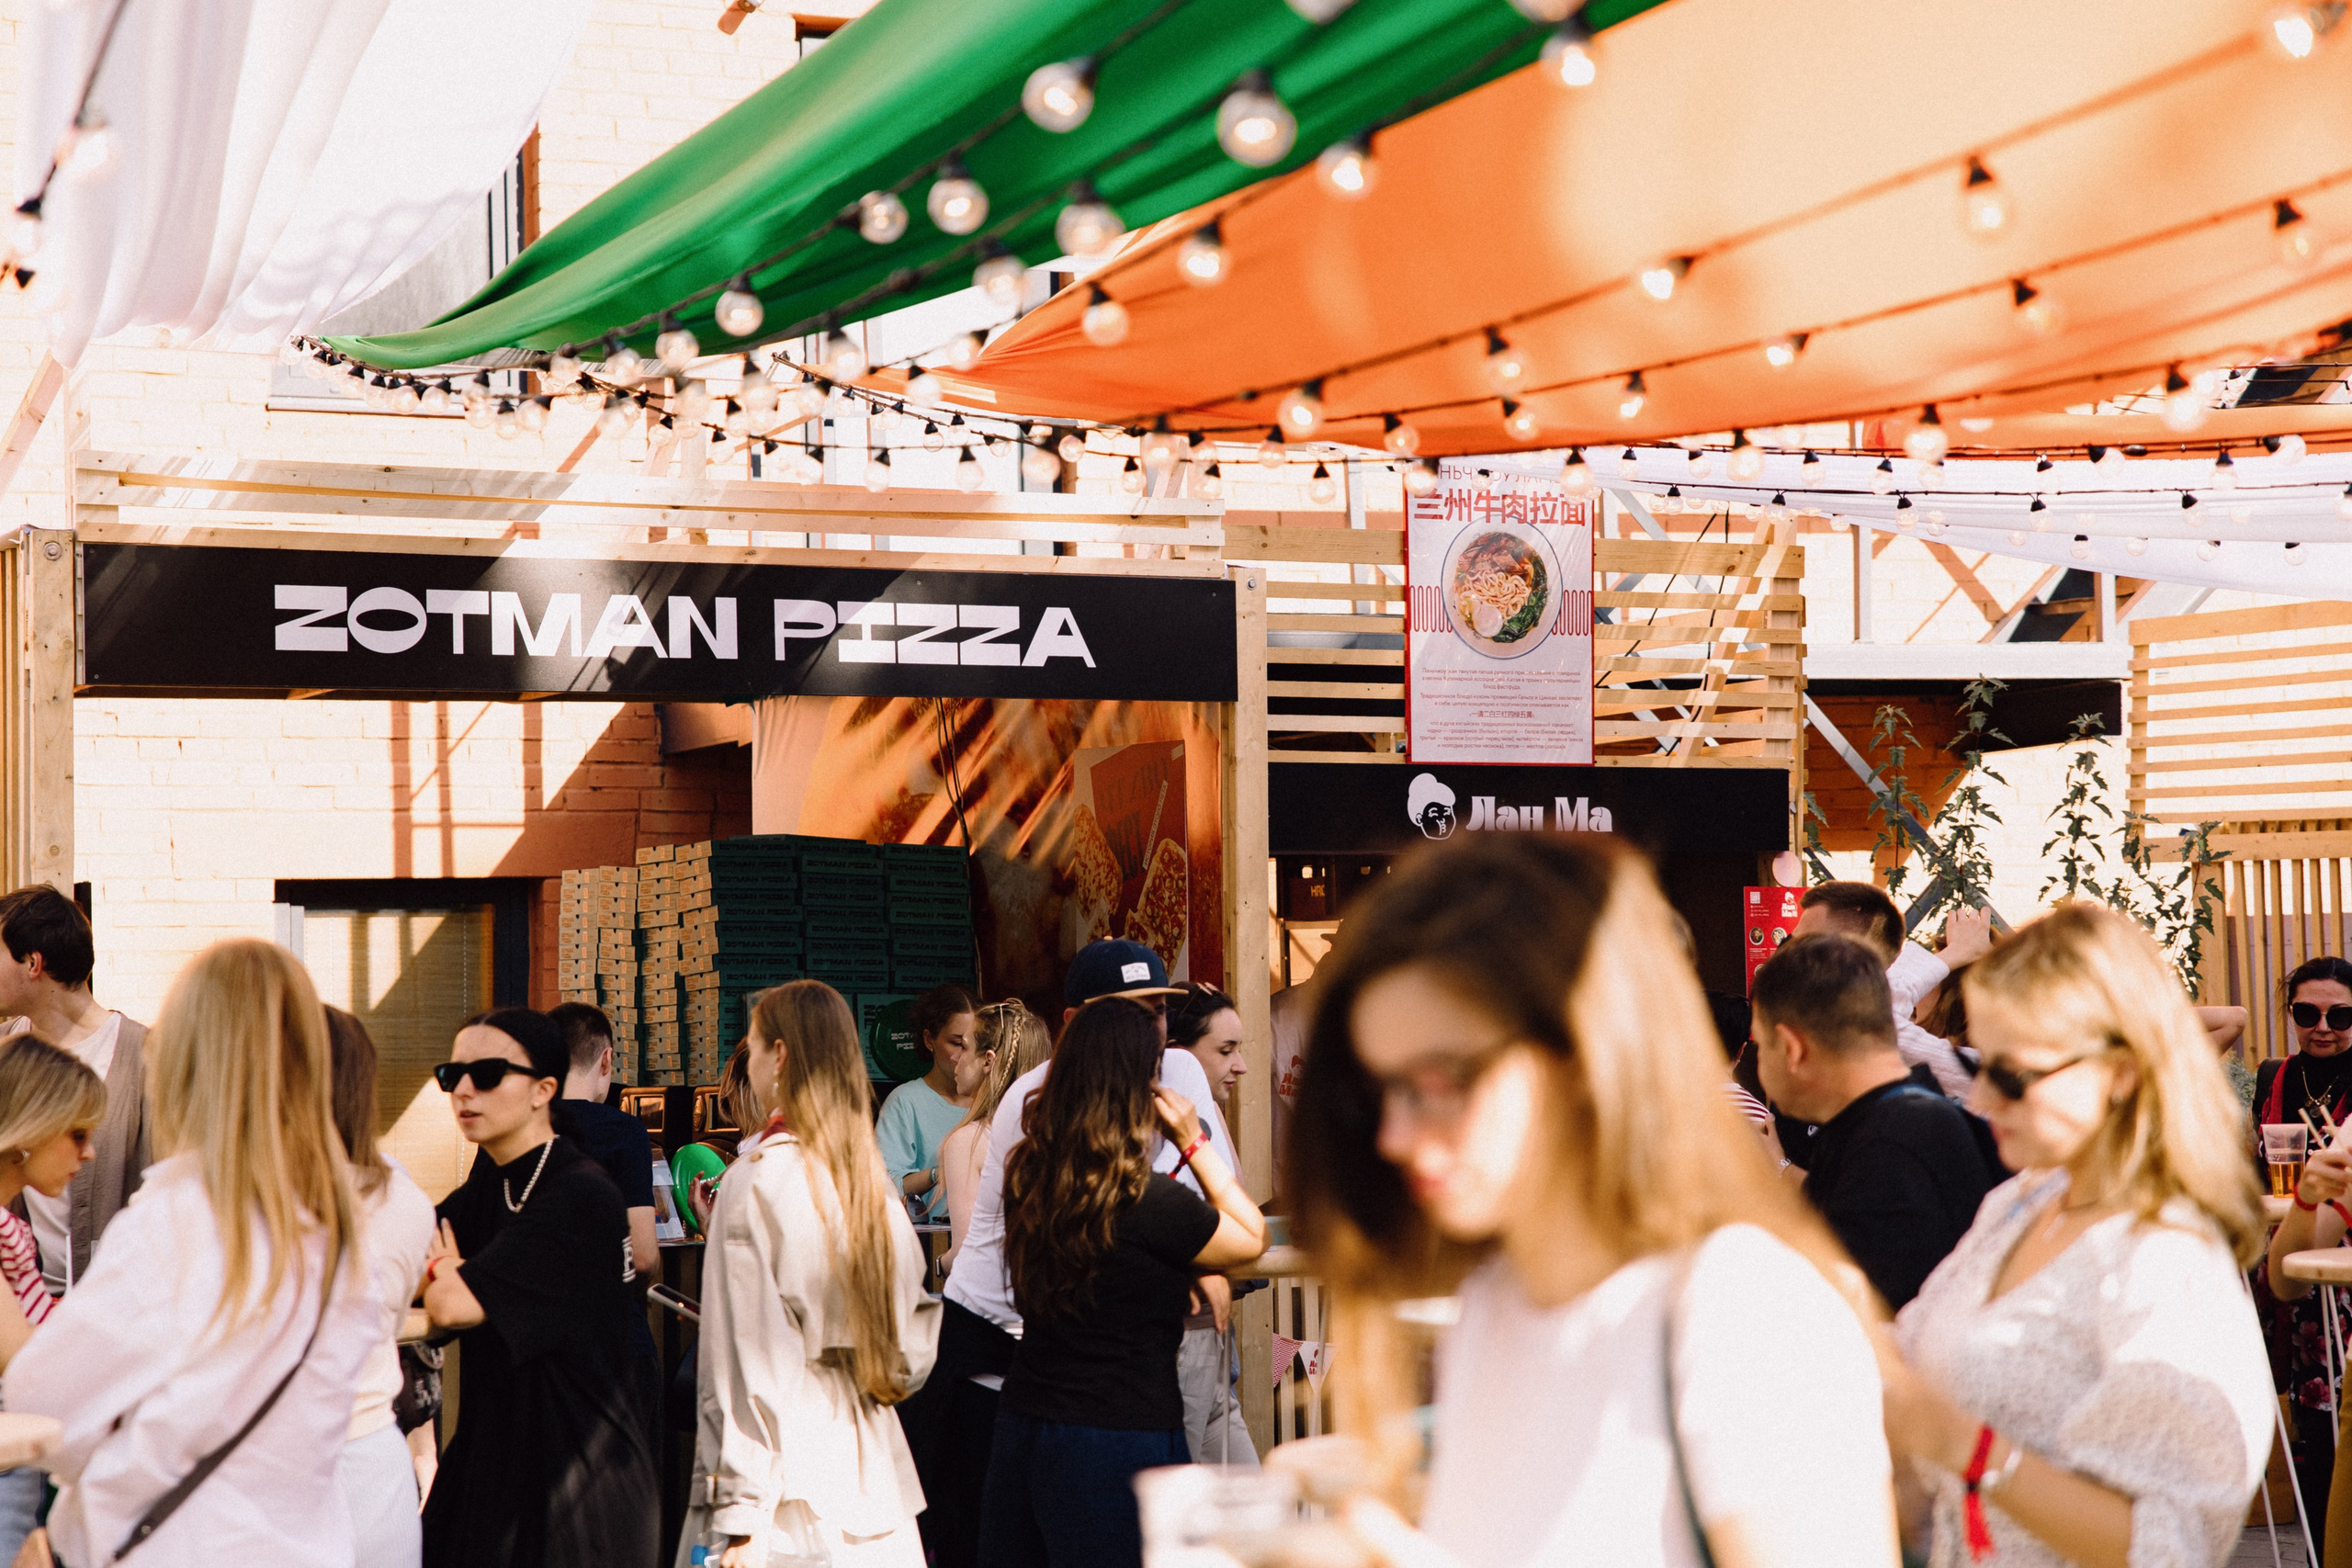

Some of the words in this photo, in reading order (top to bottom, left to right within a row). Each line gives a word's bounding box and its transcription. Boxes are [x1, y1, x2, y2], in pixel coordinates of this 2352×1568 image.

[1414, 488, 1586, 526] 兰州牛肉拉面
[275, 584, 738, 660] ZOTMAN
[774, 598, 1097, 668] PIZZA
[1466, 795, 1544, 831] Лан
[1555, 796, 1613, 831] Ма
